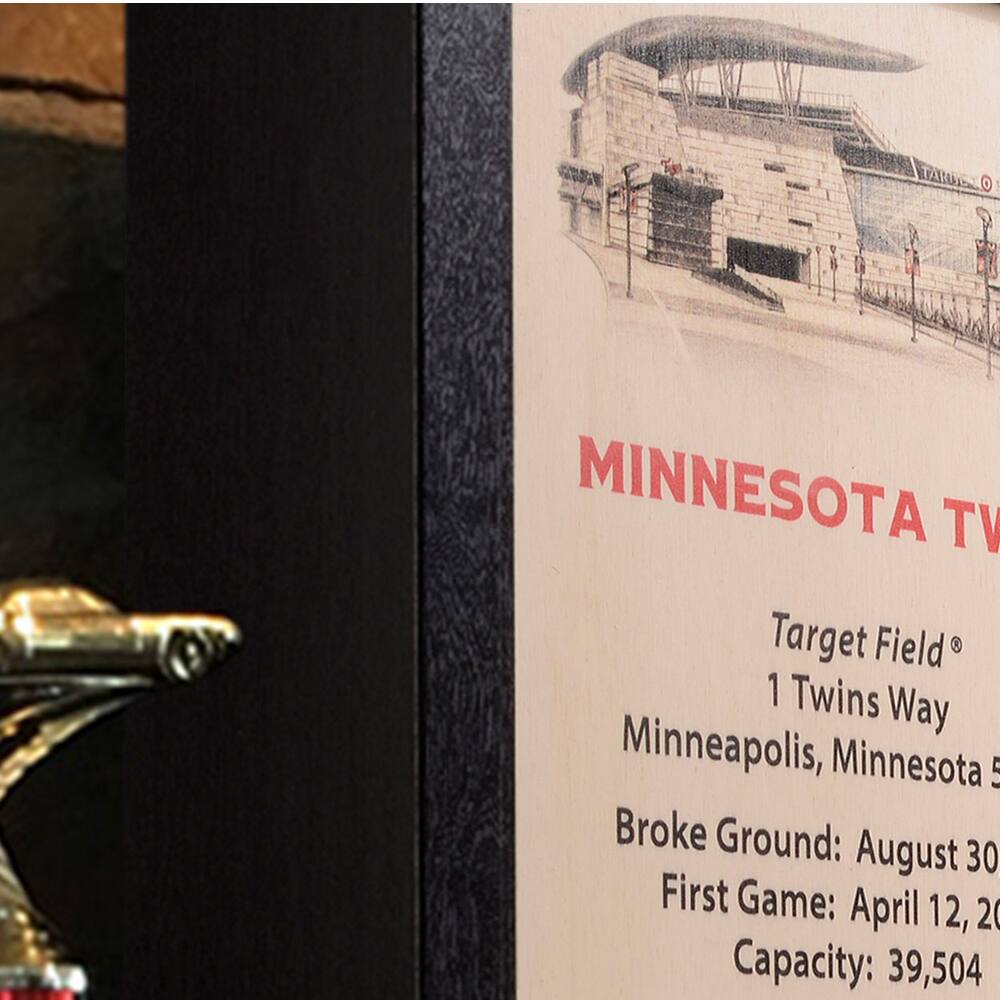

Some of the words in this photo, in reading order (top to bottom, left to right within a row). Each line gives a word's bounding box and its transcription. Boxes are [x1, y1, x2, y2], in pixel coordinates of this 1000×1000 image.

[579, 436, 926, 542] MINNESOTA
[772, 611, 868, 663] Target
[876, 625, 944, 668] Field
[768, 672, 779, 707] 1
[792, 674, 880, 719] Twins
[888, 685, 949, 735] Way
[623, 715, 823, 776] Minneapolis,
[833, 737, 982, 787] Minnesota
[617, 807, 706, 851] Broke
[717, 817, 841, 863] Ground:
[856, 829, 958, 876] August
[663, 872, 728, 913] First
[738, 879, 835, 921] Game:
[851, 887, 918, 932] April
[930, 893, 968, 934] 12,
[734, 938, 873, 990] Capacity:
[889, 948, 983, 989] 39,504
